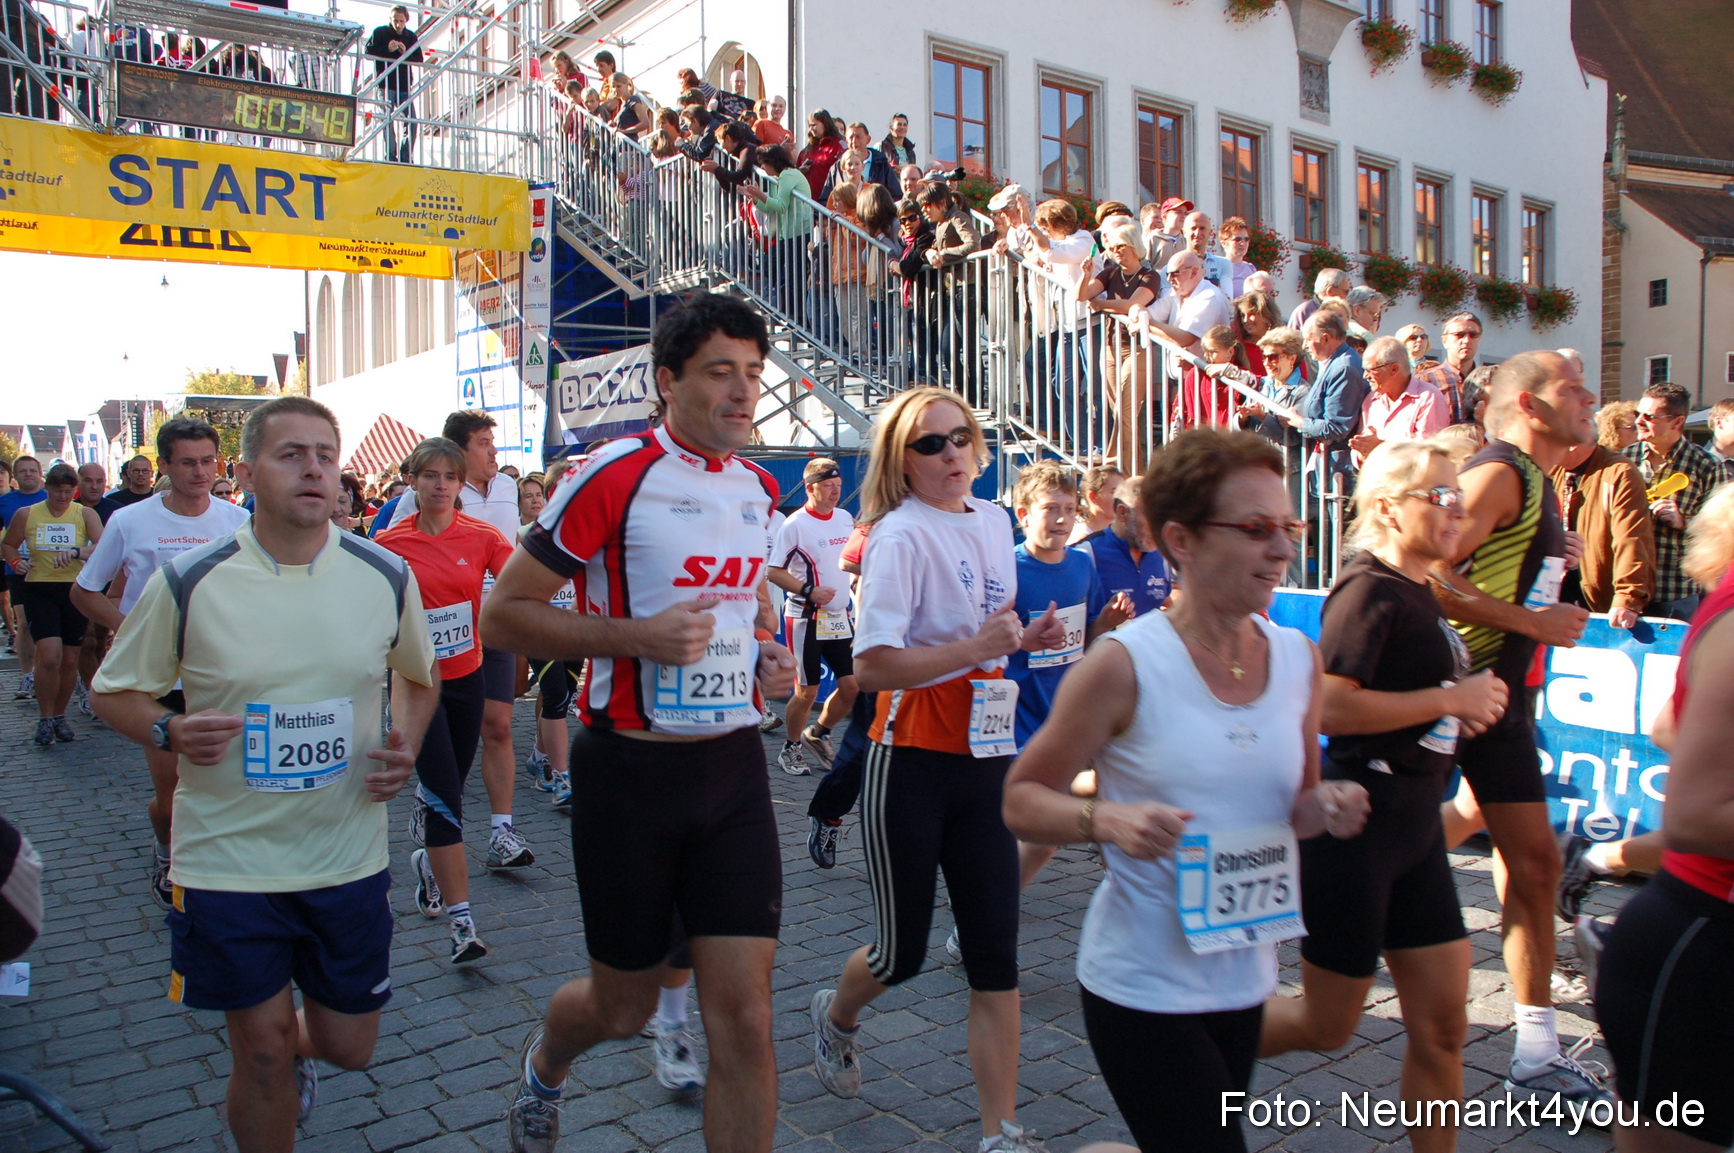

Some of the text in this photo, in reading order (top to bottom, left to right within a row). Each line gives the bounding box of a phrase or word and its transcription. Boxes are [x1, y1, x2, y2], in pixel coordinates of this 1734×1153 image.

[198, 77, 251, 92] Elektronische
[0, 169, 64, 186] tadtlauf
[108, 153, 336, 220] START
[375, 206, 498, 227] Neumarkter Stadtlauf
[319, 242, 427, 258] Neumarkter Stadtlauf
[560, 362, 649, 414] BOCK
[51, 535, 70, 544] 633
[829, 537, 849, 546] BOSC
[672, 556, 764, 588] SAT
[427, 611, 458, 625] Sandra
[830, 621, 846, 631] 366
[432, 624, 470, 646] 2170
[706, 638, 741, 657] rthold
[690, 671, 747, 698] 2213
[275, 711, 335, 729] Matthias
[278, 737, 346, 768] 2086
[1216, 873, 1290, 915] 3775
